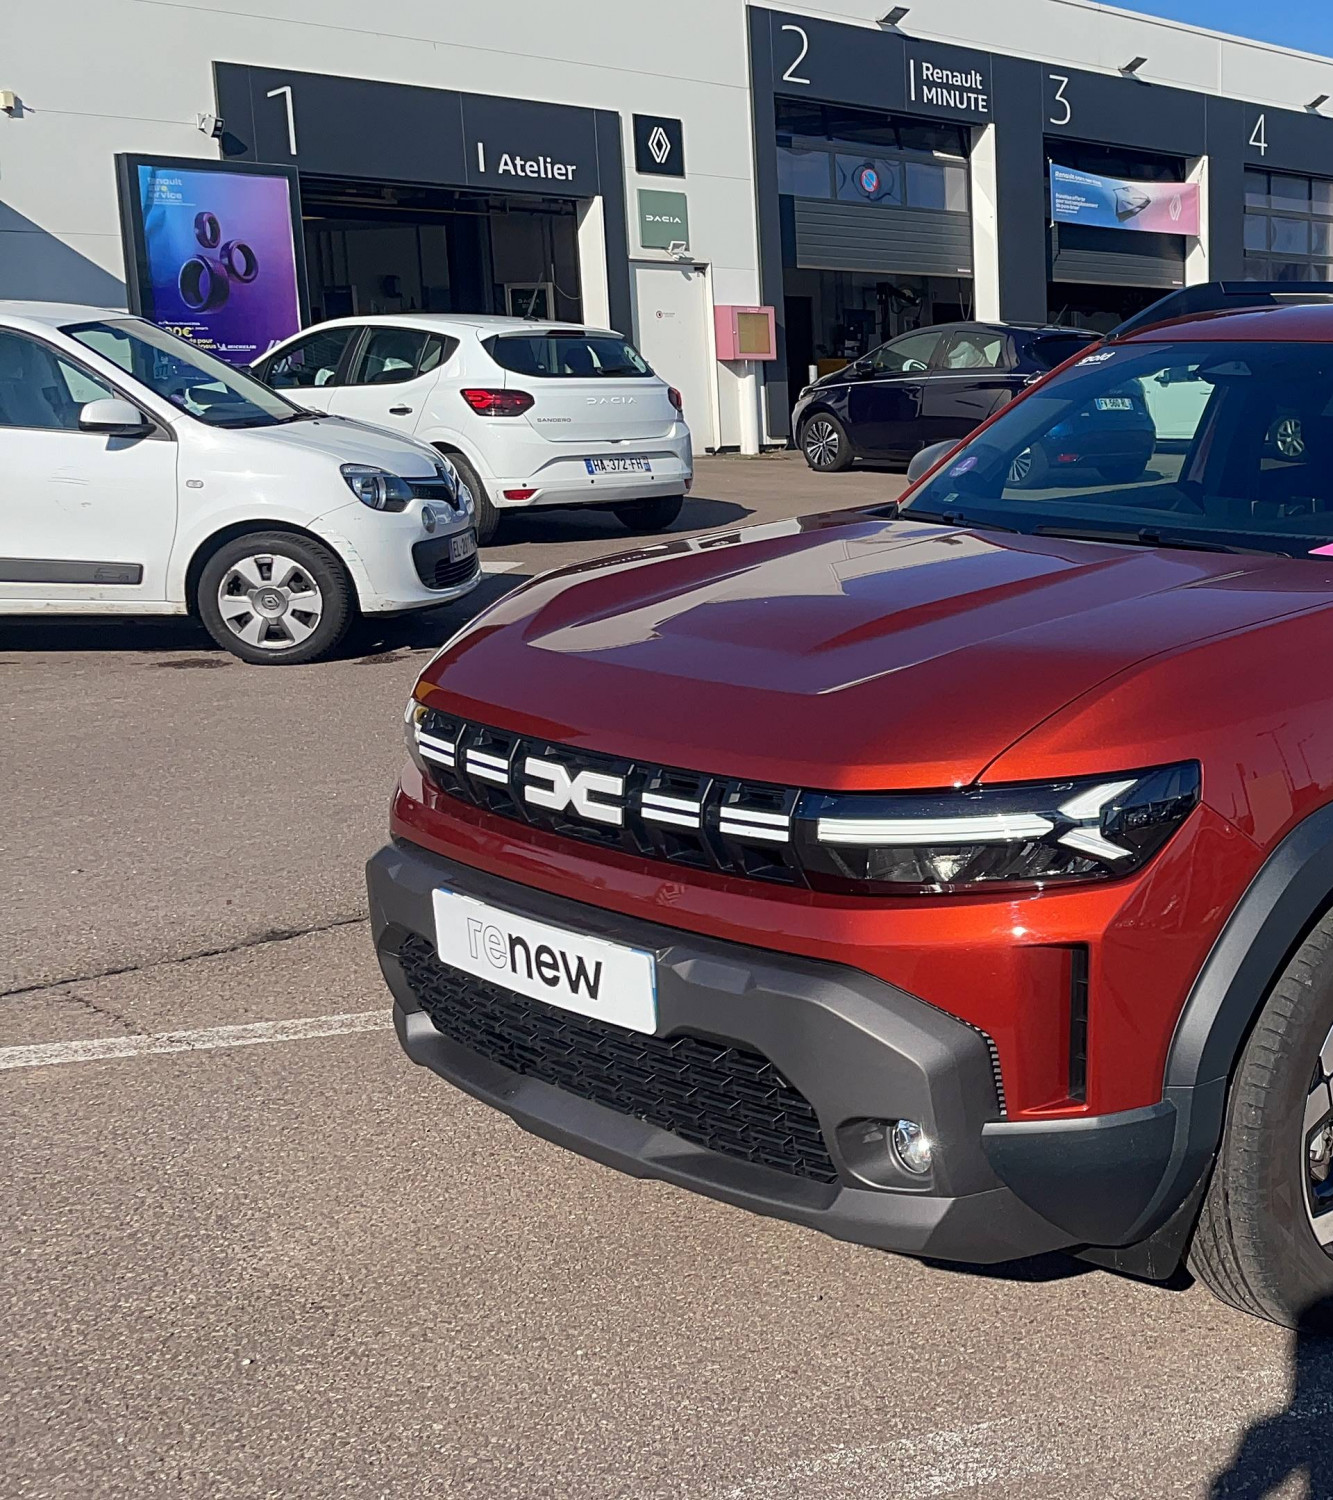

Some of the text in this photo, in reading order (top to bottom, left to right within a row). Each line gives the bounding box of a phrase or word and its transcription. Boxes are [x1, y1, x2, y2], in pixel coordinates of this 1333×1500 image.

[781, 24, 811, 85] 2
[921, 62, 983, 90] Renault
[922, 85, 988, 113] MINUTE
[1048, 74, 1071, 126] 3
[266, 85, 297, 155] 1
[1248, 113, 1268, 156] 4
[497, 152, 577, 181] Atelier
[645, 214, 682, 224] DACIA
[586, 397, 638, 405] DACIA
[592, 457, 643, 472] HA-372-FH
[466, 917, 603, 1001] renew
